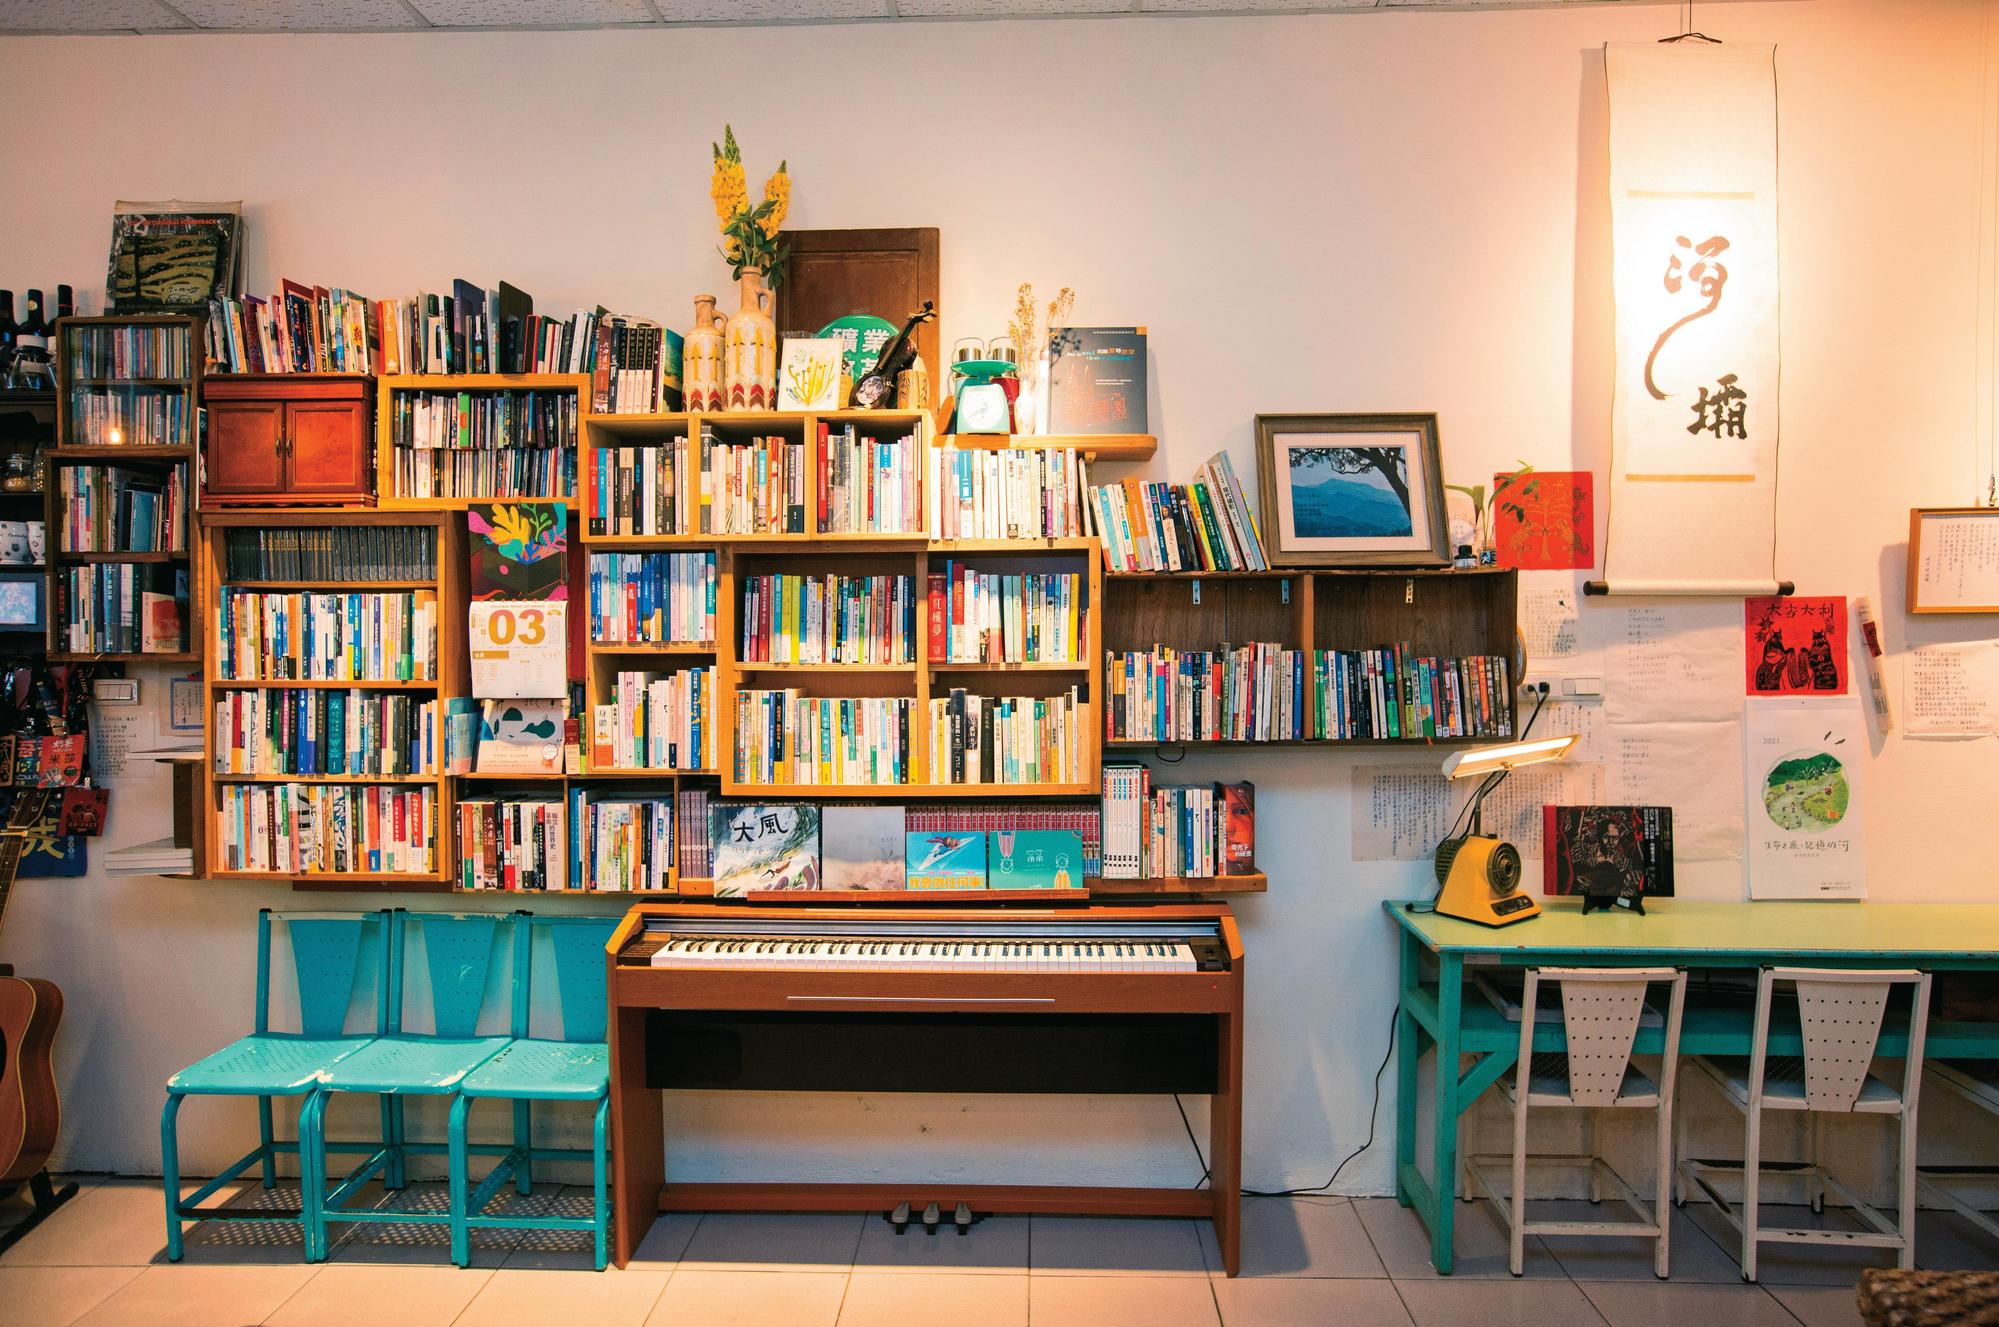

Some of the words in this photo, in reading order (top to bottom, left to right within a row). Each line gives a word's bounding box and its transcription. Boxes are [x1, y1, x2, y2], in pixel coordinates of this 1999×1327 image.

[1767, 603, 1835, 619] 大吉大利
[488, 609, 546, 646] 03
[733, 812, 789, 843] 大風
